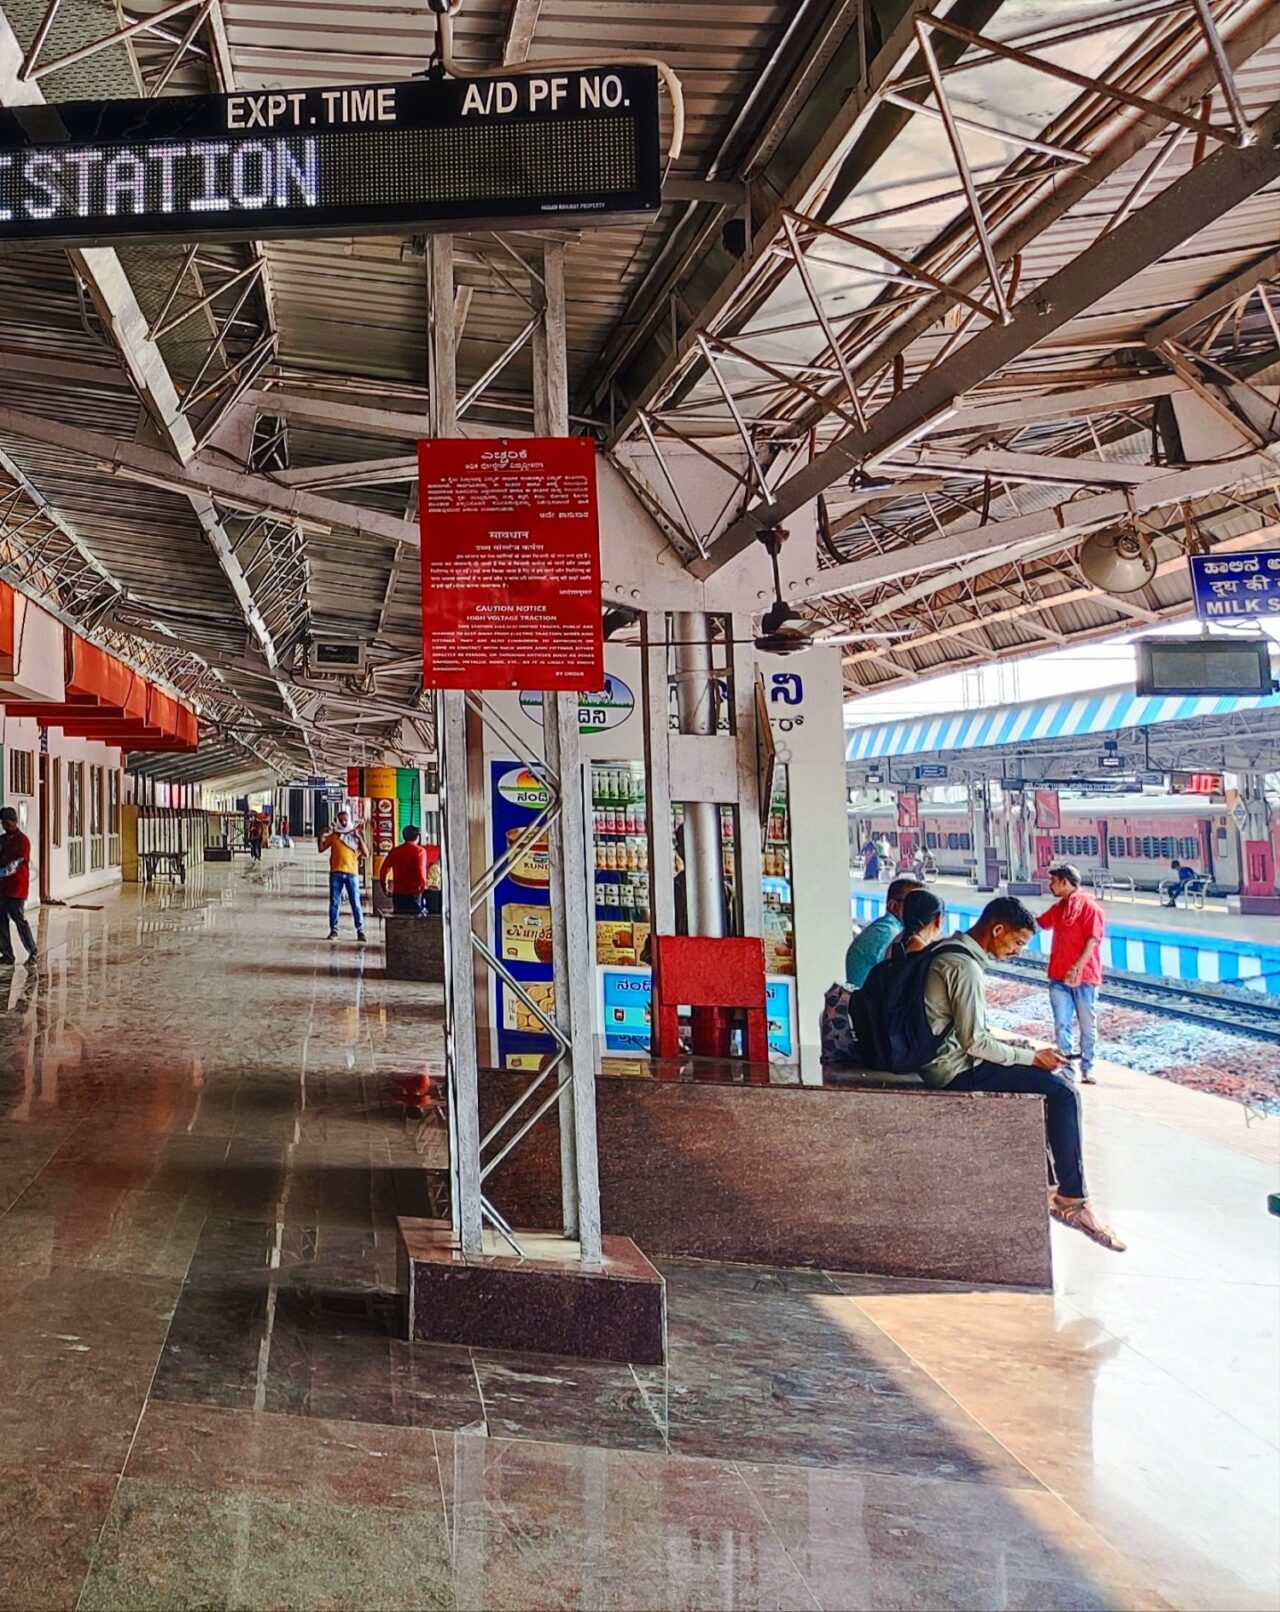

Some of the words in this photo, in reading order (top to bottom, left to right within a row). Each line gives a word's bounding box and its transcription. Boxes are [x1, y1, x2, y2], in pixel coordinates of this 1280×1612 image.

[461, 82, 517, 116] A/D
[530, 78, 569, 111] PF
[580, 75, 630, 108] NO.
[24, 138, 317, 218] STATION
[488, 531, 529, 539] सावधान
[1209, 579, 1240, 598] दूध
[1242, 574, 1271, 591] की
[1206, 598, 1262, 615] MILK
[517, 791, 548, 802] ನಂದಿ
[523, 861, 549, 870] KUN
